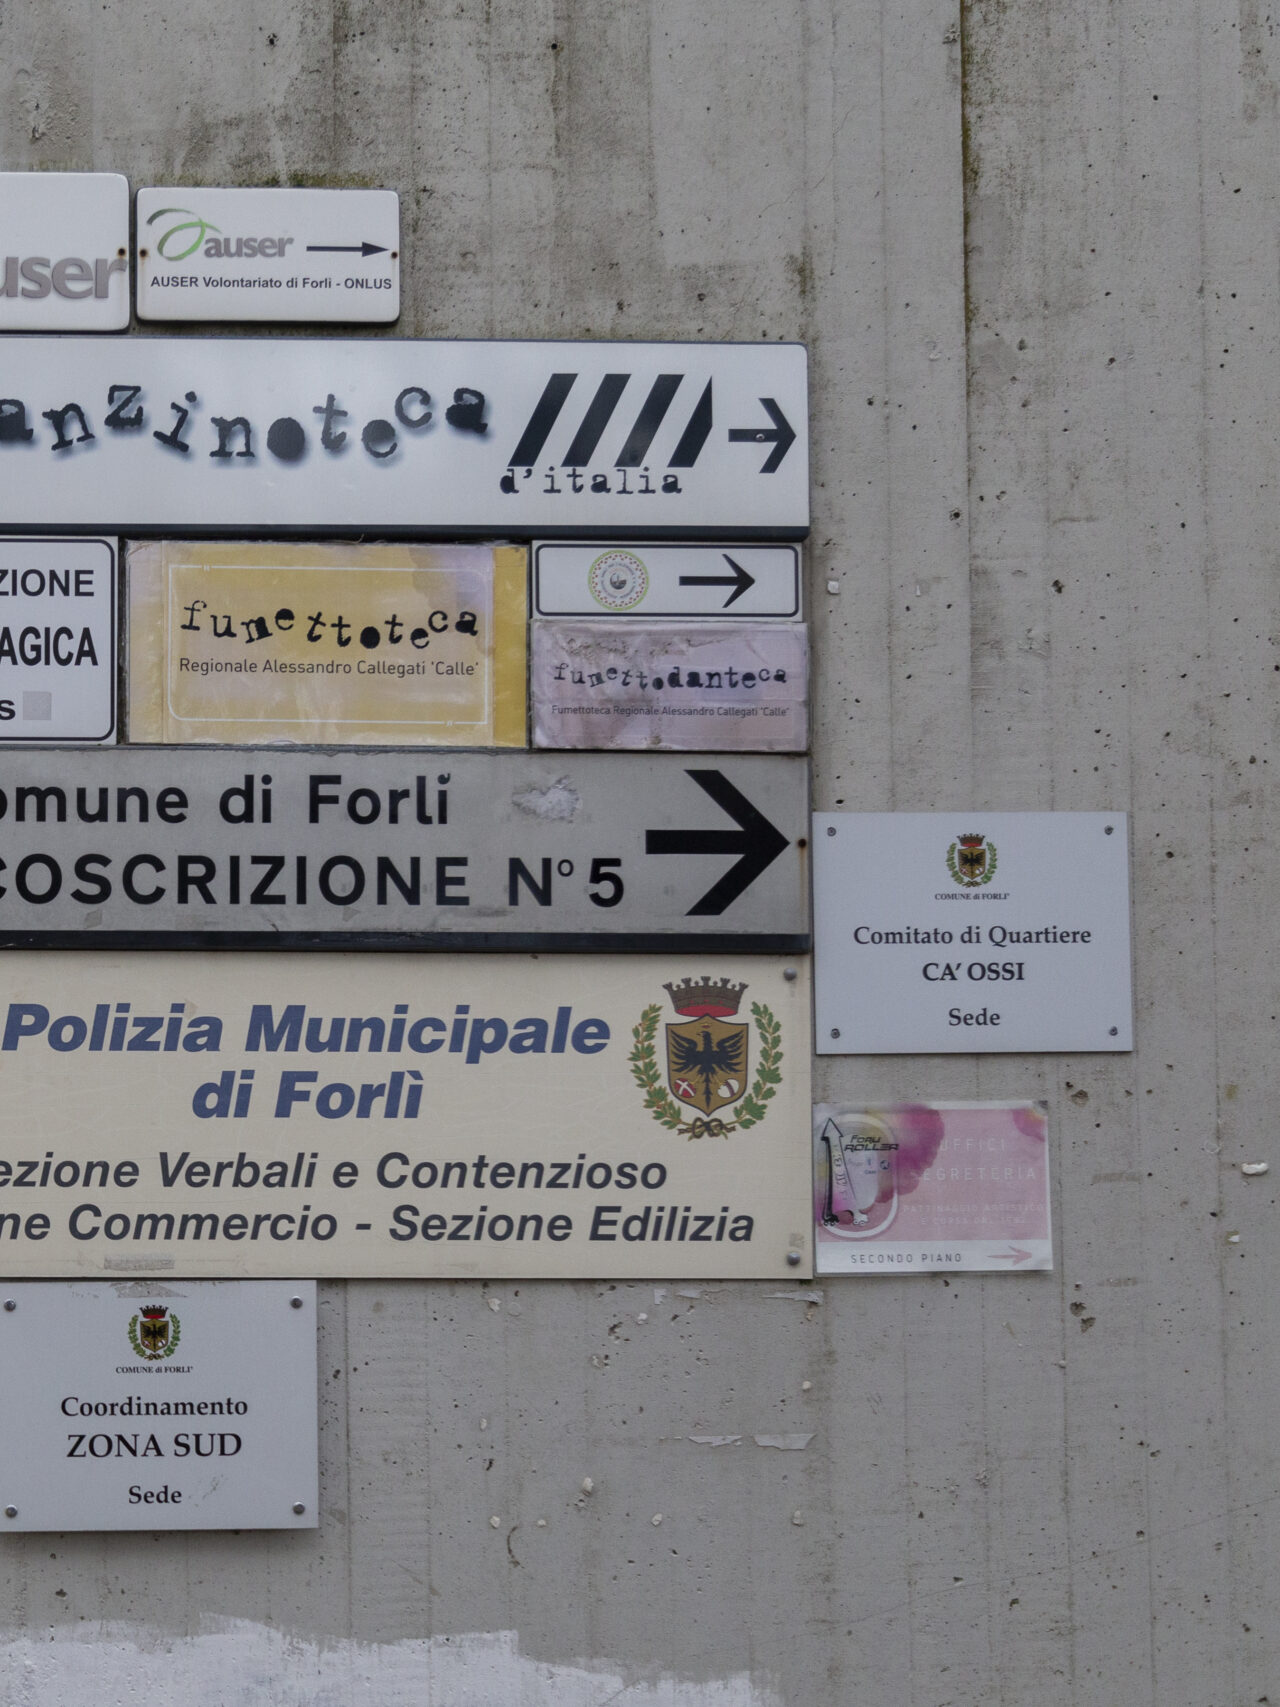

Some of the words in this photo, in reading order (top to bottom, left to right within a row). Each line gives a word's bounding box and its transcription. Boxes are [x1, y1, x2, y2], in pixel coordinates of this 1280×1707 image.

[204, 238, 294, 258] auser
[151, 277, 198, 287] AUSER
[203, 277, 282, 288] Volontariato
[286, 278, 297, 288] di
[345, 278, 391, 289] ONLUS
[497, 465, 684, 495] d'italia
[180, 600, 479, 649] fumettoteca
[180, 658, 257, 675] Regionale
[263, 659, 351, 673] Alessandro
[357, 660, 425, 678] Callegati
[554, 662, 787, 690] fumettodanteca
[551, 704, 610, 715] Fumettoteca
[613, 704, 659, 717] Regionale
[662, 705, 714, 716] Alessandro
[717, 706, 758, 718] Callegati
[219, 775, 272, 824] di
[934, 892, 971, 900] COMUNE
[972, 891, 981, 900] di
[854, 926, 953, 944] Comitato
[960, 926, 981, 943] di
[989, 926, 1091, 947] Quartiere
[968, 962, 1024, 981] OSSI
[949, 1008, 1000, 1026] Sede
[2, 1003, 222, 1052] Polizia
[245, 1004, 610, 1064] Municipale
[192, 1070, 255, 1118] di
[275, 1070, 423, 1119] Forlì
[160, 1152, 318, 1188] Verbali
[333, 1162, 358, 1188] e
[377, 1152, 667, 1189] Contenzioso
[69, 1204, 337, 1240] Commercio
[389, 1205, 572, 1241] Sezione
[589, 1206, 753, 1241] Edilizia
[850, 1254, 913, 1263] SECONDO
[921, 1253, 962, 1262] PIANO
[115, 1366, 154, 1374] COMUNE
[154, 1366, 163, 1374] di
[61, 1397, 247, 1416] Coordinamento
[67, 1434, 164, 1457] ZONA
[174, 1434, 241, 1457] SUD
[129, 1485, 181, 1504] Sede
